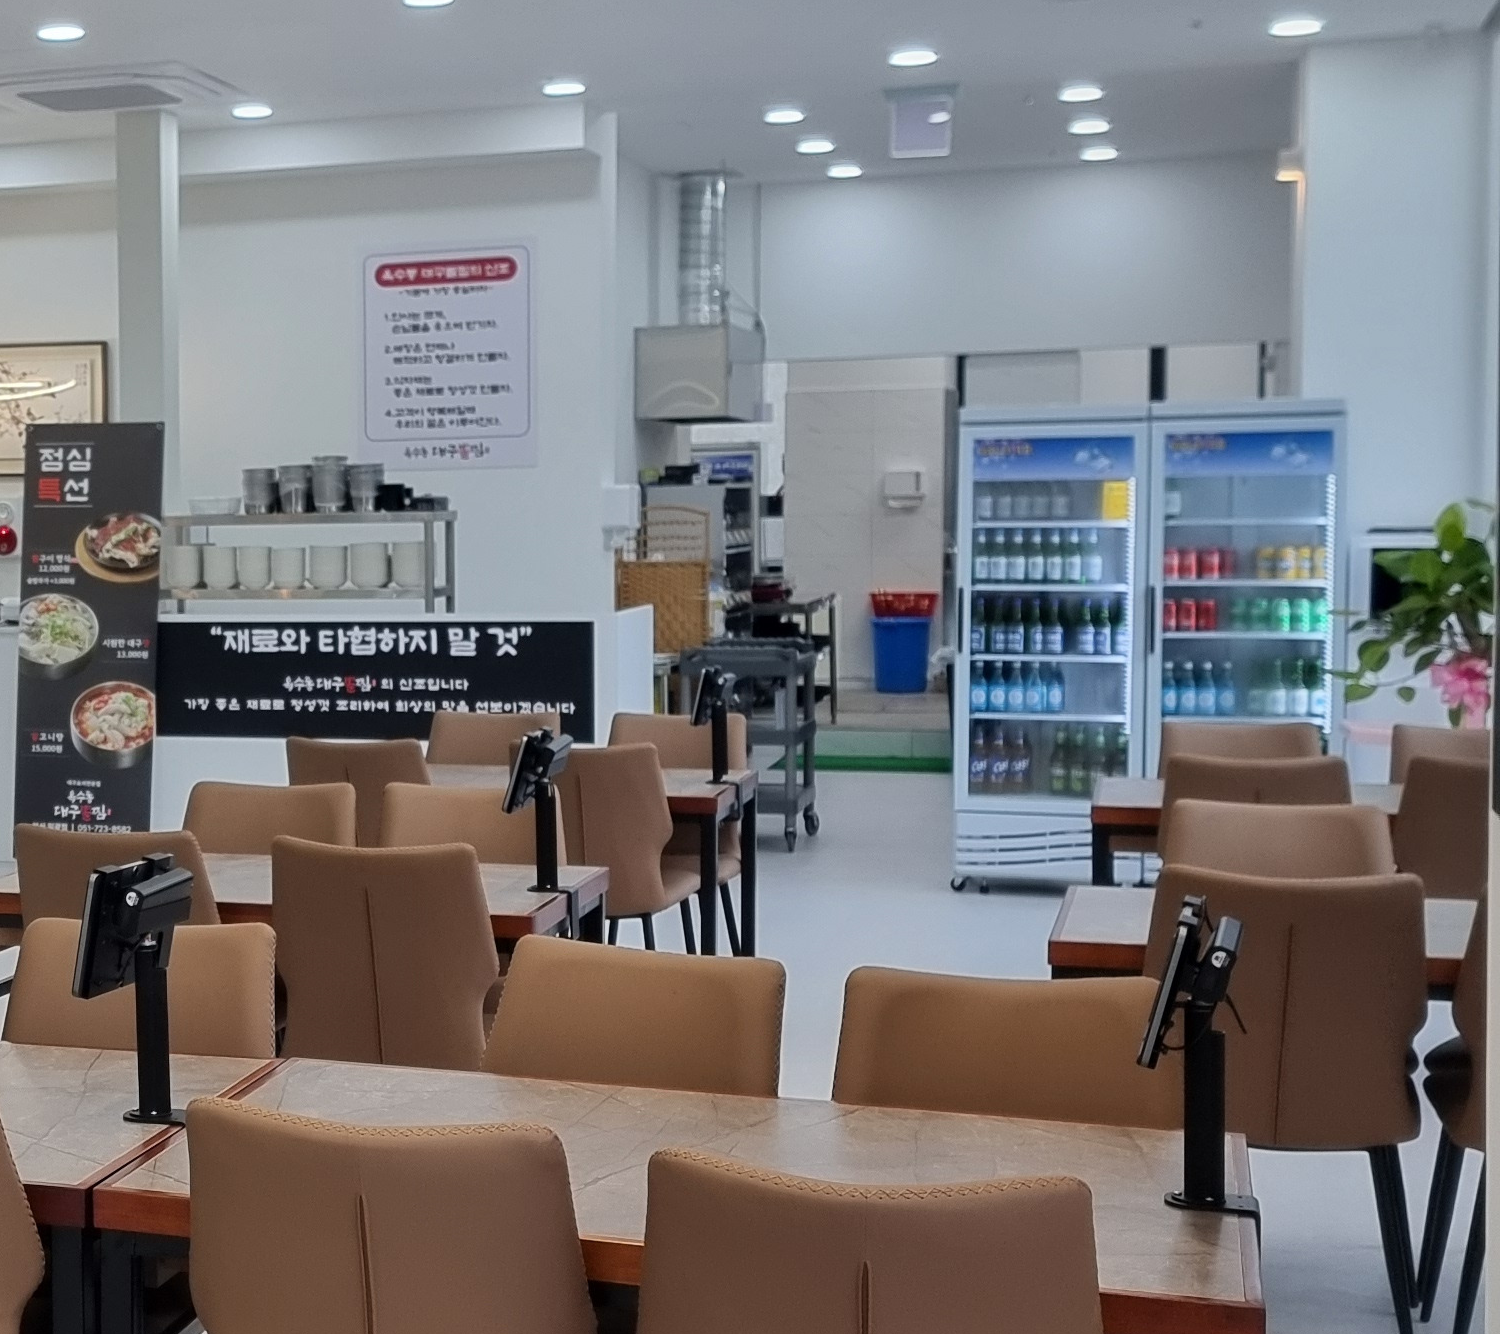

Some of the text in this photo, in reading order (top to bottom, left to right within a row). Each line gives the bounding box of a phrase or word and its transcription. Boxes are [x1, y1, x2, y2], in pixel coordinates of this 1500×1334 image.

[38, 447, 92, 472] 점심
[37, 477, 90, 503] 특선
[317, 625, 438, 657] 타협하지
[447, 625, 481, 657] 말
[282, 675, 315, 692] 옥수동
[380, 678, 394, 691] 의
[399, 678, 470, 692] 신조입니다
[183, 698, 210, 711] 가장
[214, 697, 241, 712] 좋은
[246, 698, 285, 711] 재료로
[290, 698, 330, 713] 정성껏
[335, 699, 390, 713] 조리하여
[395, 699, 436, 713] 최상의
[475, 700, 576, 715] 선보이겠습니다
[66, 789, 95, 804] 옥수동
